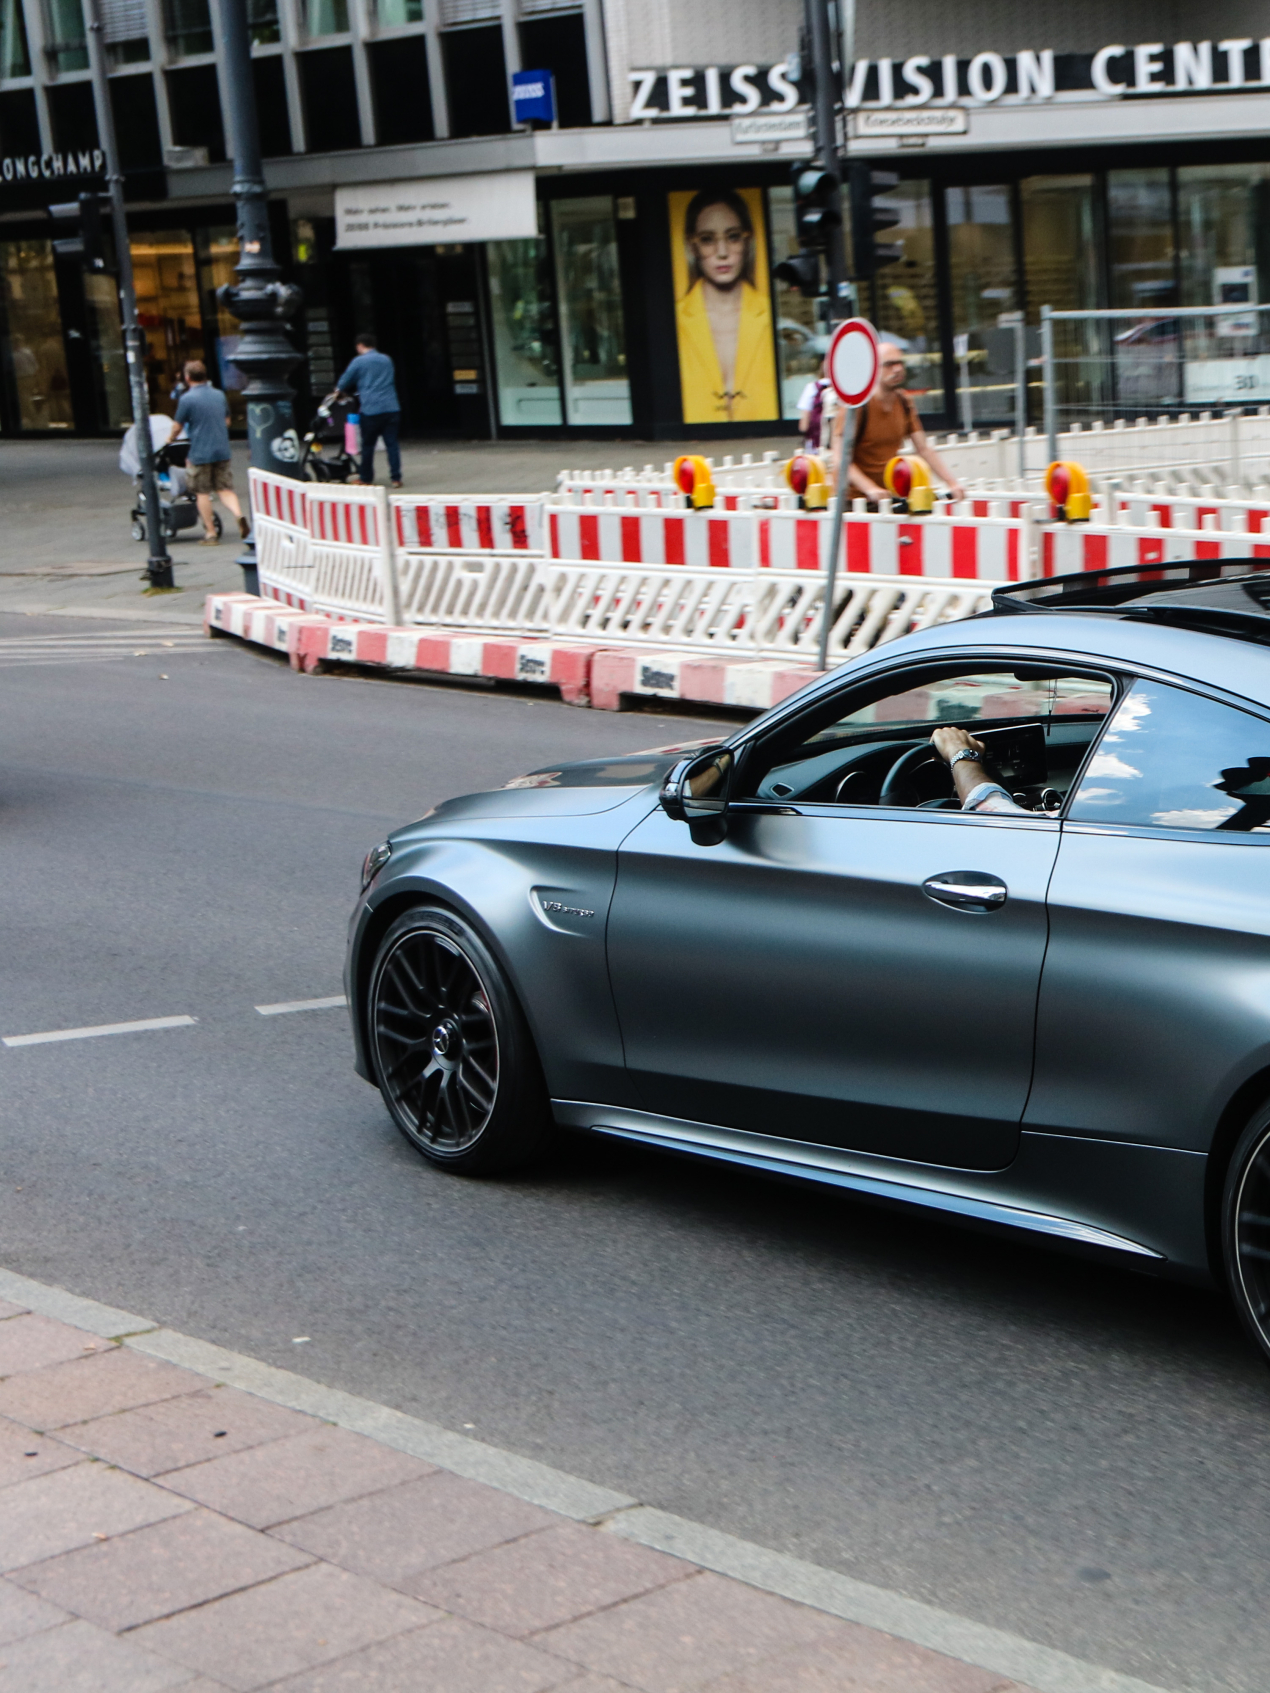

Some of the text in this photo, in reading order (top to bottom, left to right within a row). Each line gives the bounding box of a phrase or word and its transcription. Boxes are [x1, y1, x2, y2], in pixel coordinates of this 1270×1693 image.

[627, 65, 799, 119] ZEISS
[843, 51, 1056, 109] VISION
[0, 149, 103, 183] ONGCHAMP
